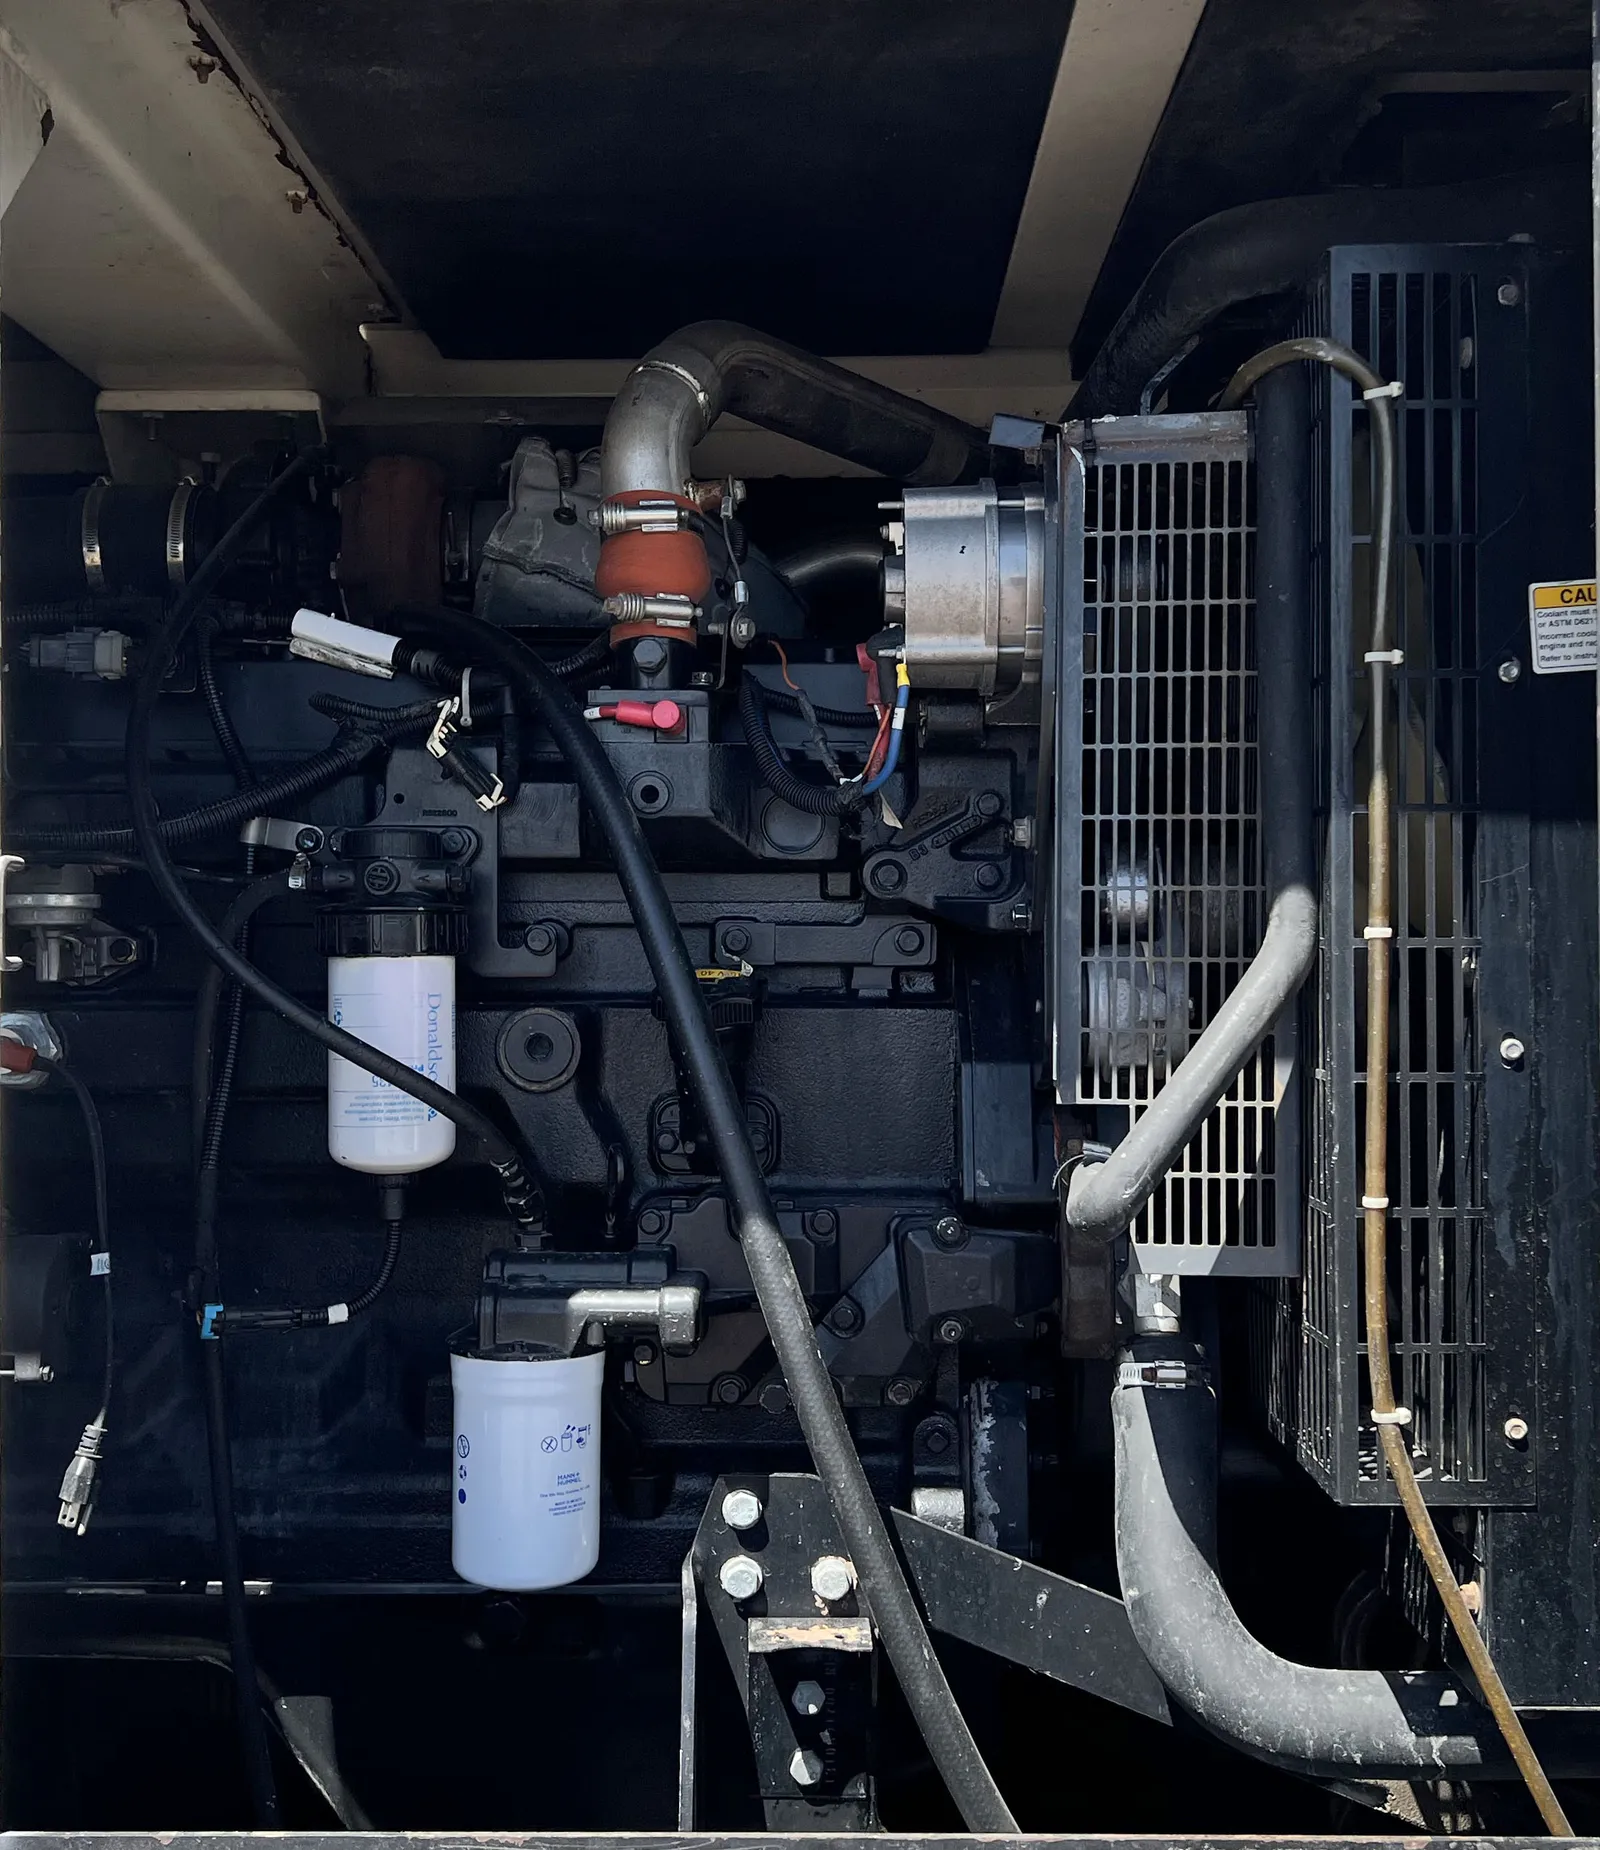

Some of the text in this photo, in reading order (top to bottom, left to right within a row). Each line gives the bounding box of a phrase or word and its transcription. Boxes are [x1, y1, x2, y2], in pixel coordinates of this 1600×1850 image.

[1537, 609, 1568, 618] Coolant
[1570, 608, 1590, 616] must
[1548, 618, 1572, 628] ASTM
[1574, 617, 1597, 626] D621
[1539, 631, 1574, 640] Incorrect
[1539, 642, 1566, 651] engine
[1568, 640, 1583, 648] and
[1540, 654, 1562, 662] Refer
[1563, 653, 1571, 661] to
[427, 993, 443, 1082] Donaldso
